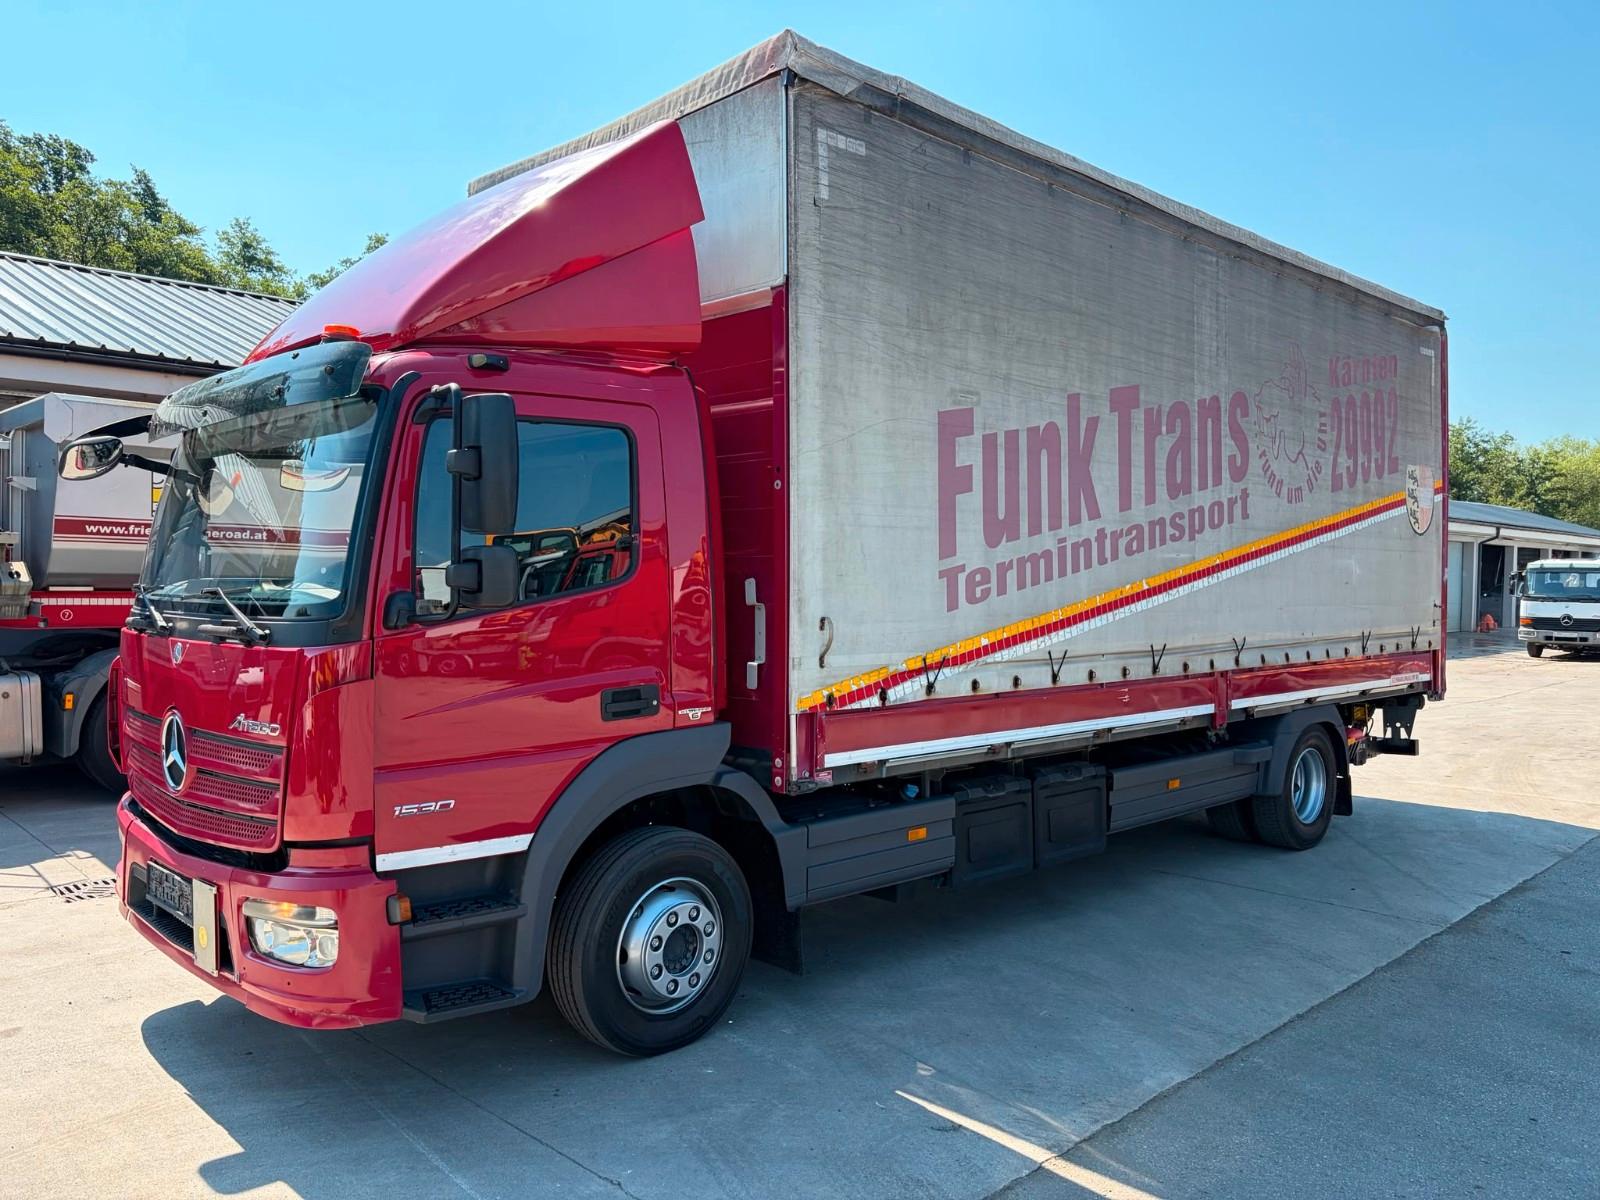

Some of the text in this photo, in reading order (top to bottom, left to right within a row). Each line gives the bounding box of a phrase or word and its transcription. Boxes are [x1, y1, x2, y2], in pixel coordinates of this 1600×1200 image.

[1330, 387, 1399, 493] 29992
[1287, 486, 1304, 504] um
[938, 487, 1251, 614] Termintransport
[393, 799, 456, 819] 1530
